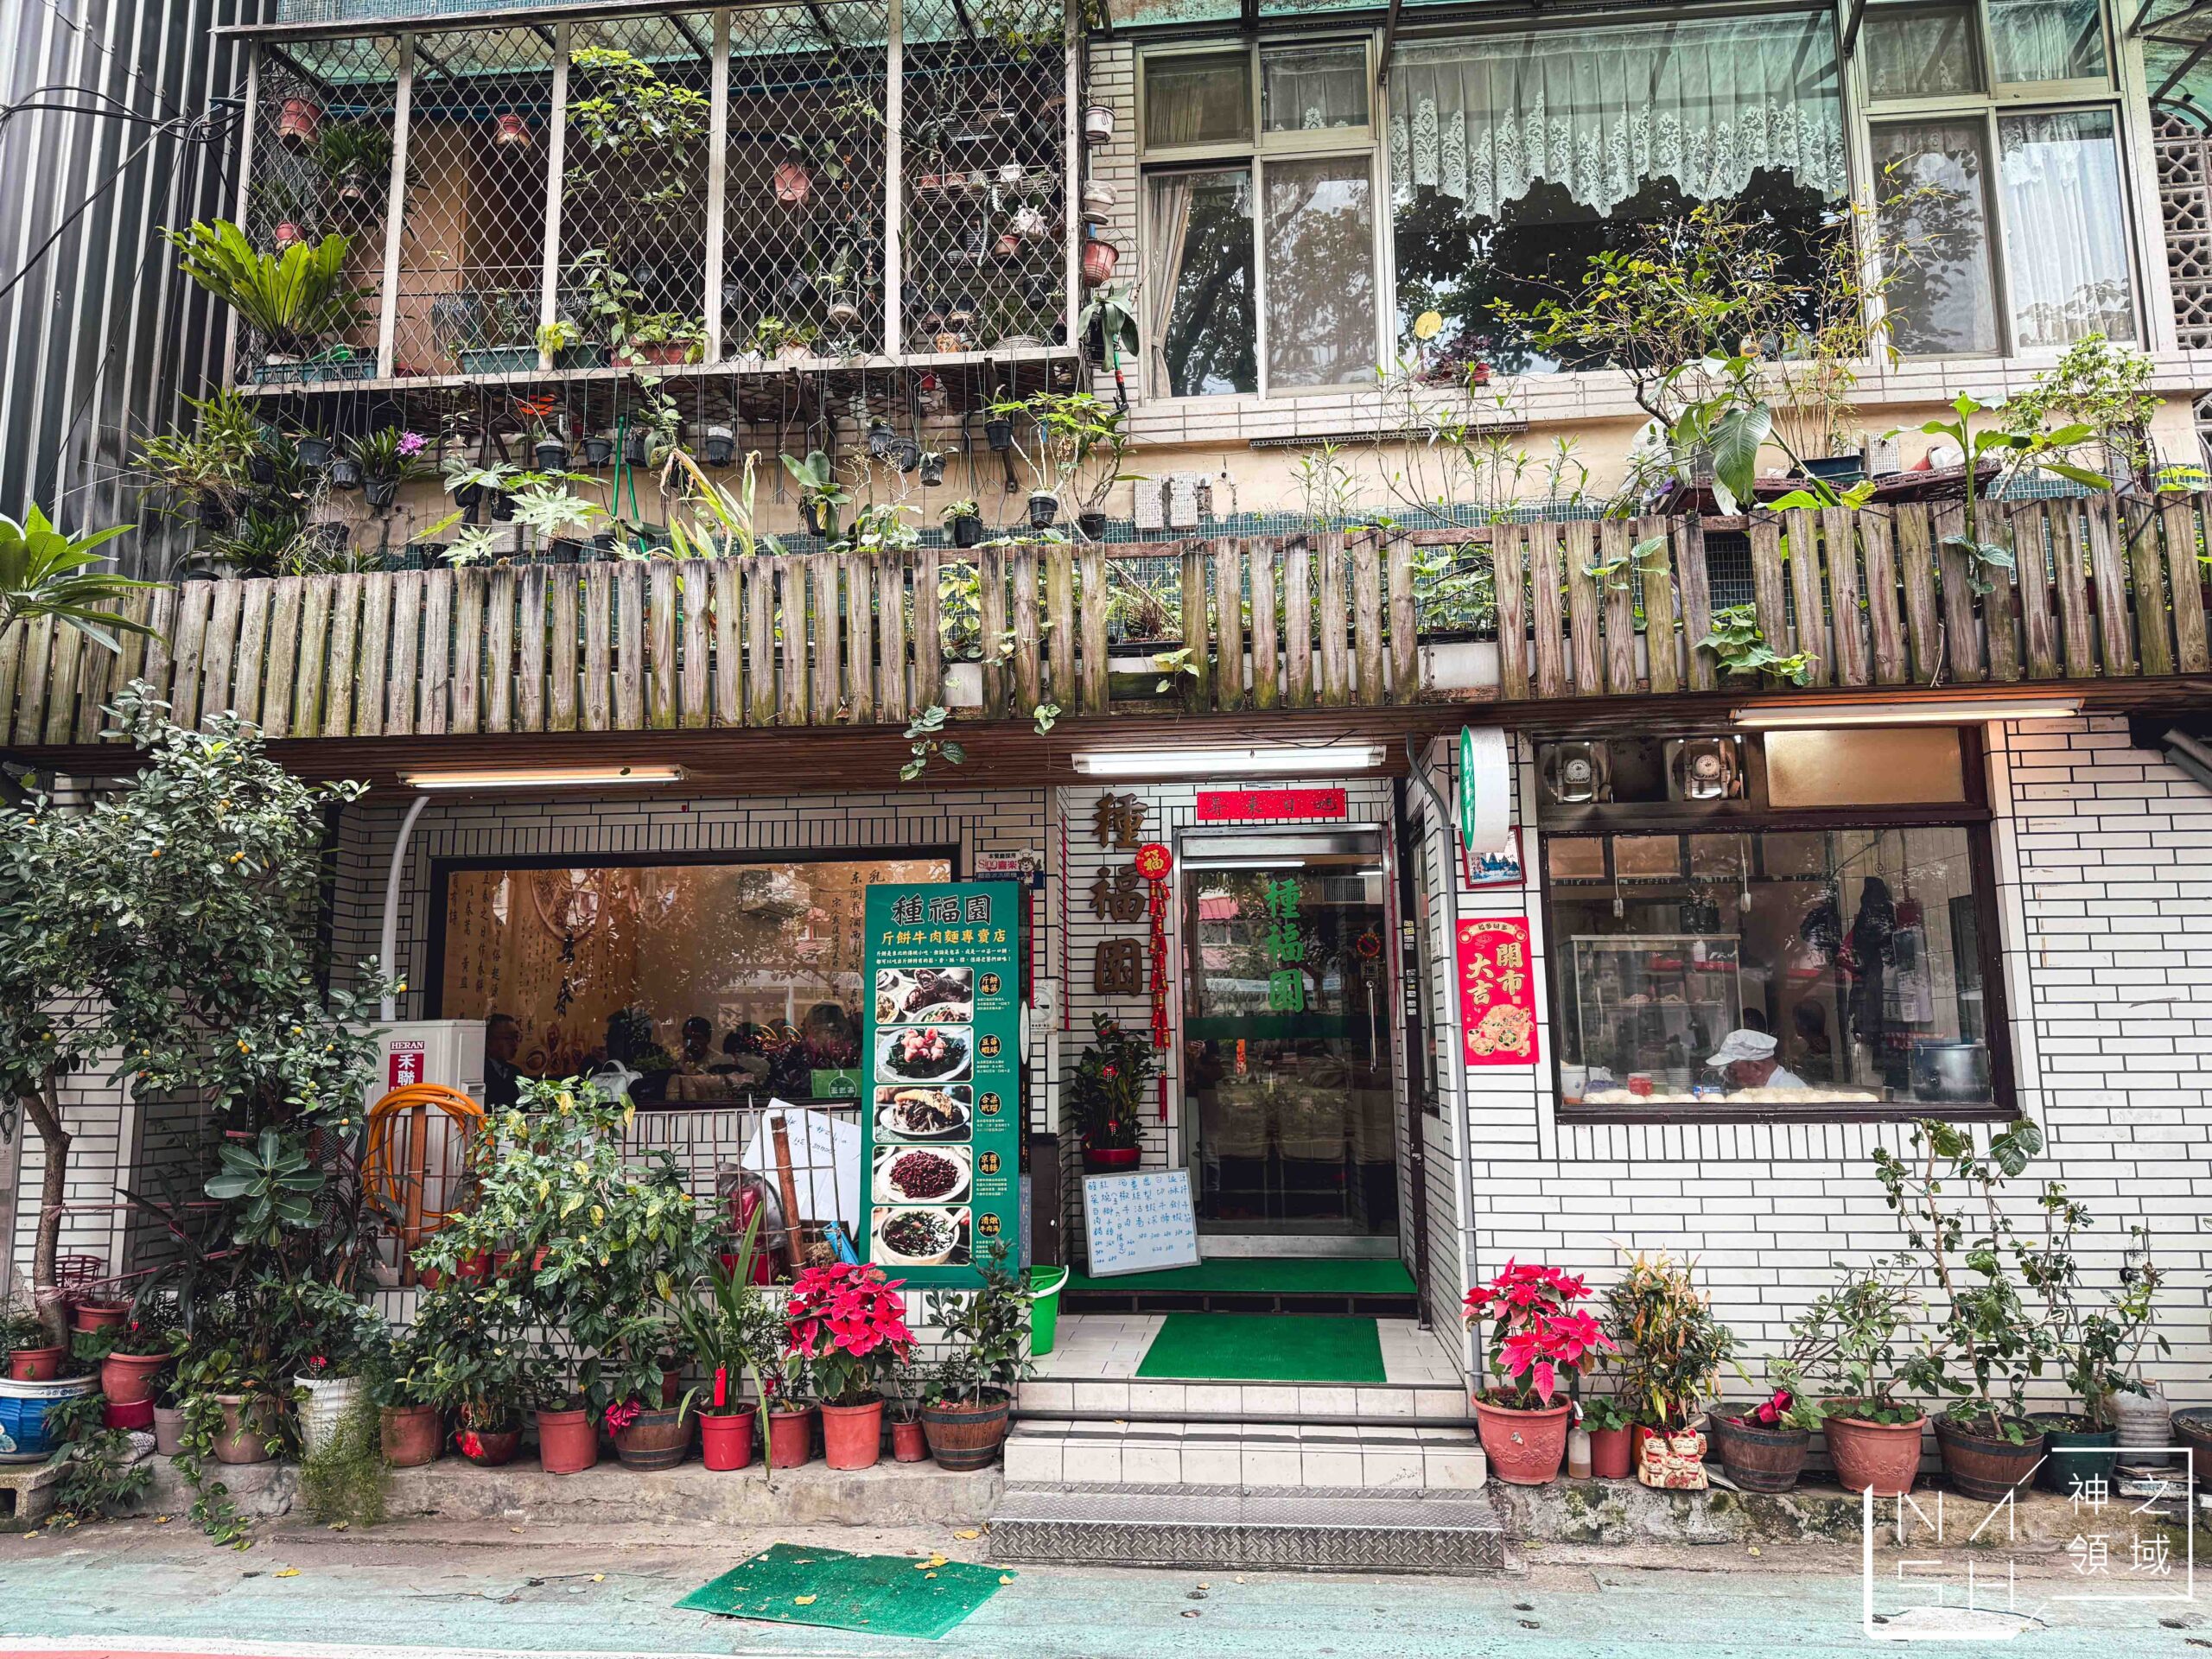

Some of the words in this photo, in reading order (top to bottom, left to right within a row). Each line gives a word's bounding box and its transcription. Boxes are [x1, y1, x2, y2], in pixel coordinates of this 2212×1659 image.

[1143, 849, 1164, 871] 福
[891, 893, 993, 926] 種福園
[1090, 792, 1148, 996] 種福園
[881, 928, 1007, 945] 斤餅牛肉麵專賣店
[1264, 878, 1304, 1013] 種福園
[982, 976, 998, 985] 斤餅
[1466, 952, 1495, 1005] 大吉
[1496, 941, 1526, 996] 開市
[391, 1041, 423, 1050] HERAN
[397, 1054, 416, 1086] 禾聯
